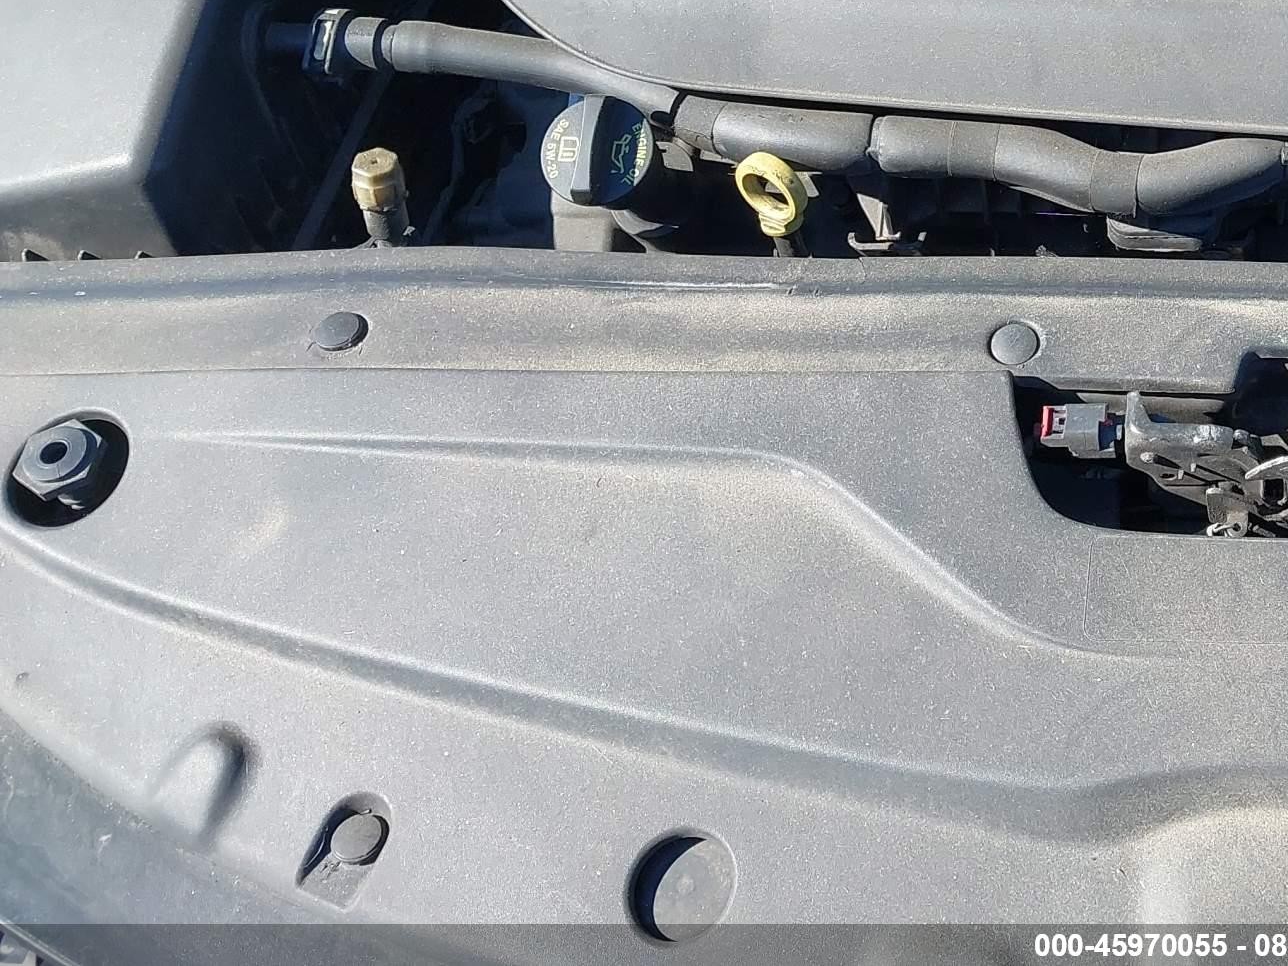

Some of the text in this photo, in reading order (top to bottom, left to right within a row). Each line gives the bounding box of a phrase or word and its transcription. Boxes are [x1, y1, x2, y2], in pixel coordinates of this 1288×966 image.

[546, 118, 570, 179] SAE 5W-20
[620, 122, 647, 186] ENGINE OIL
